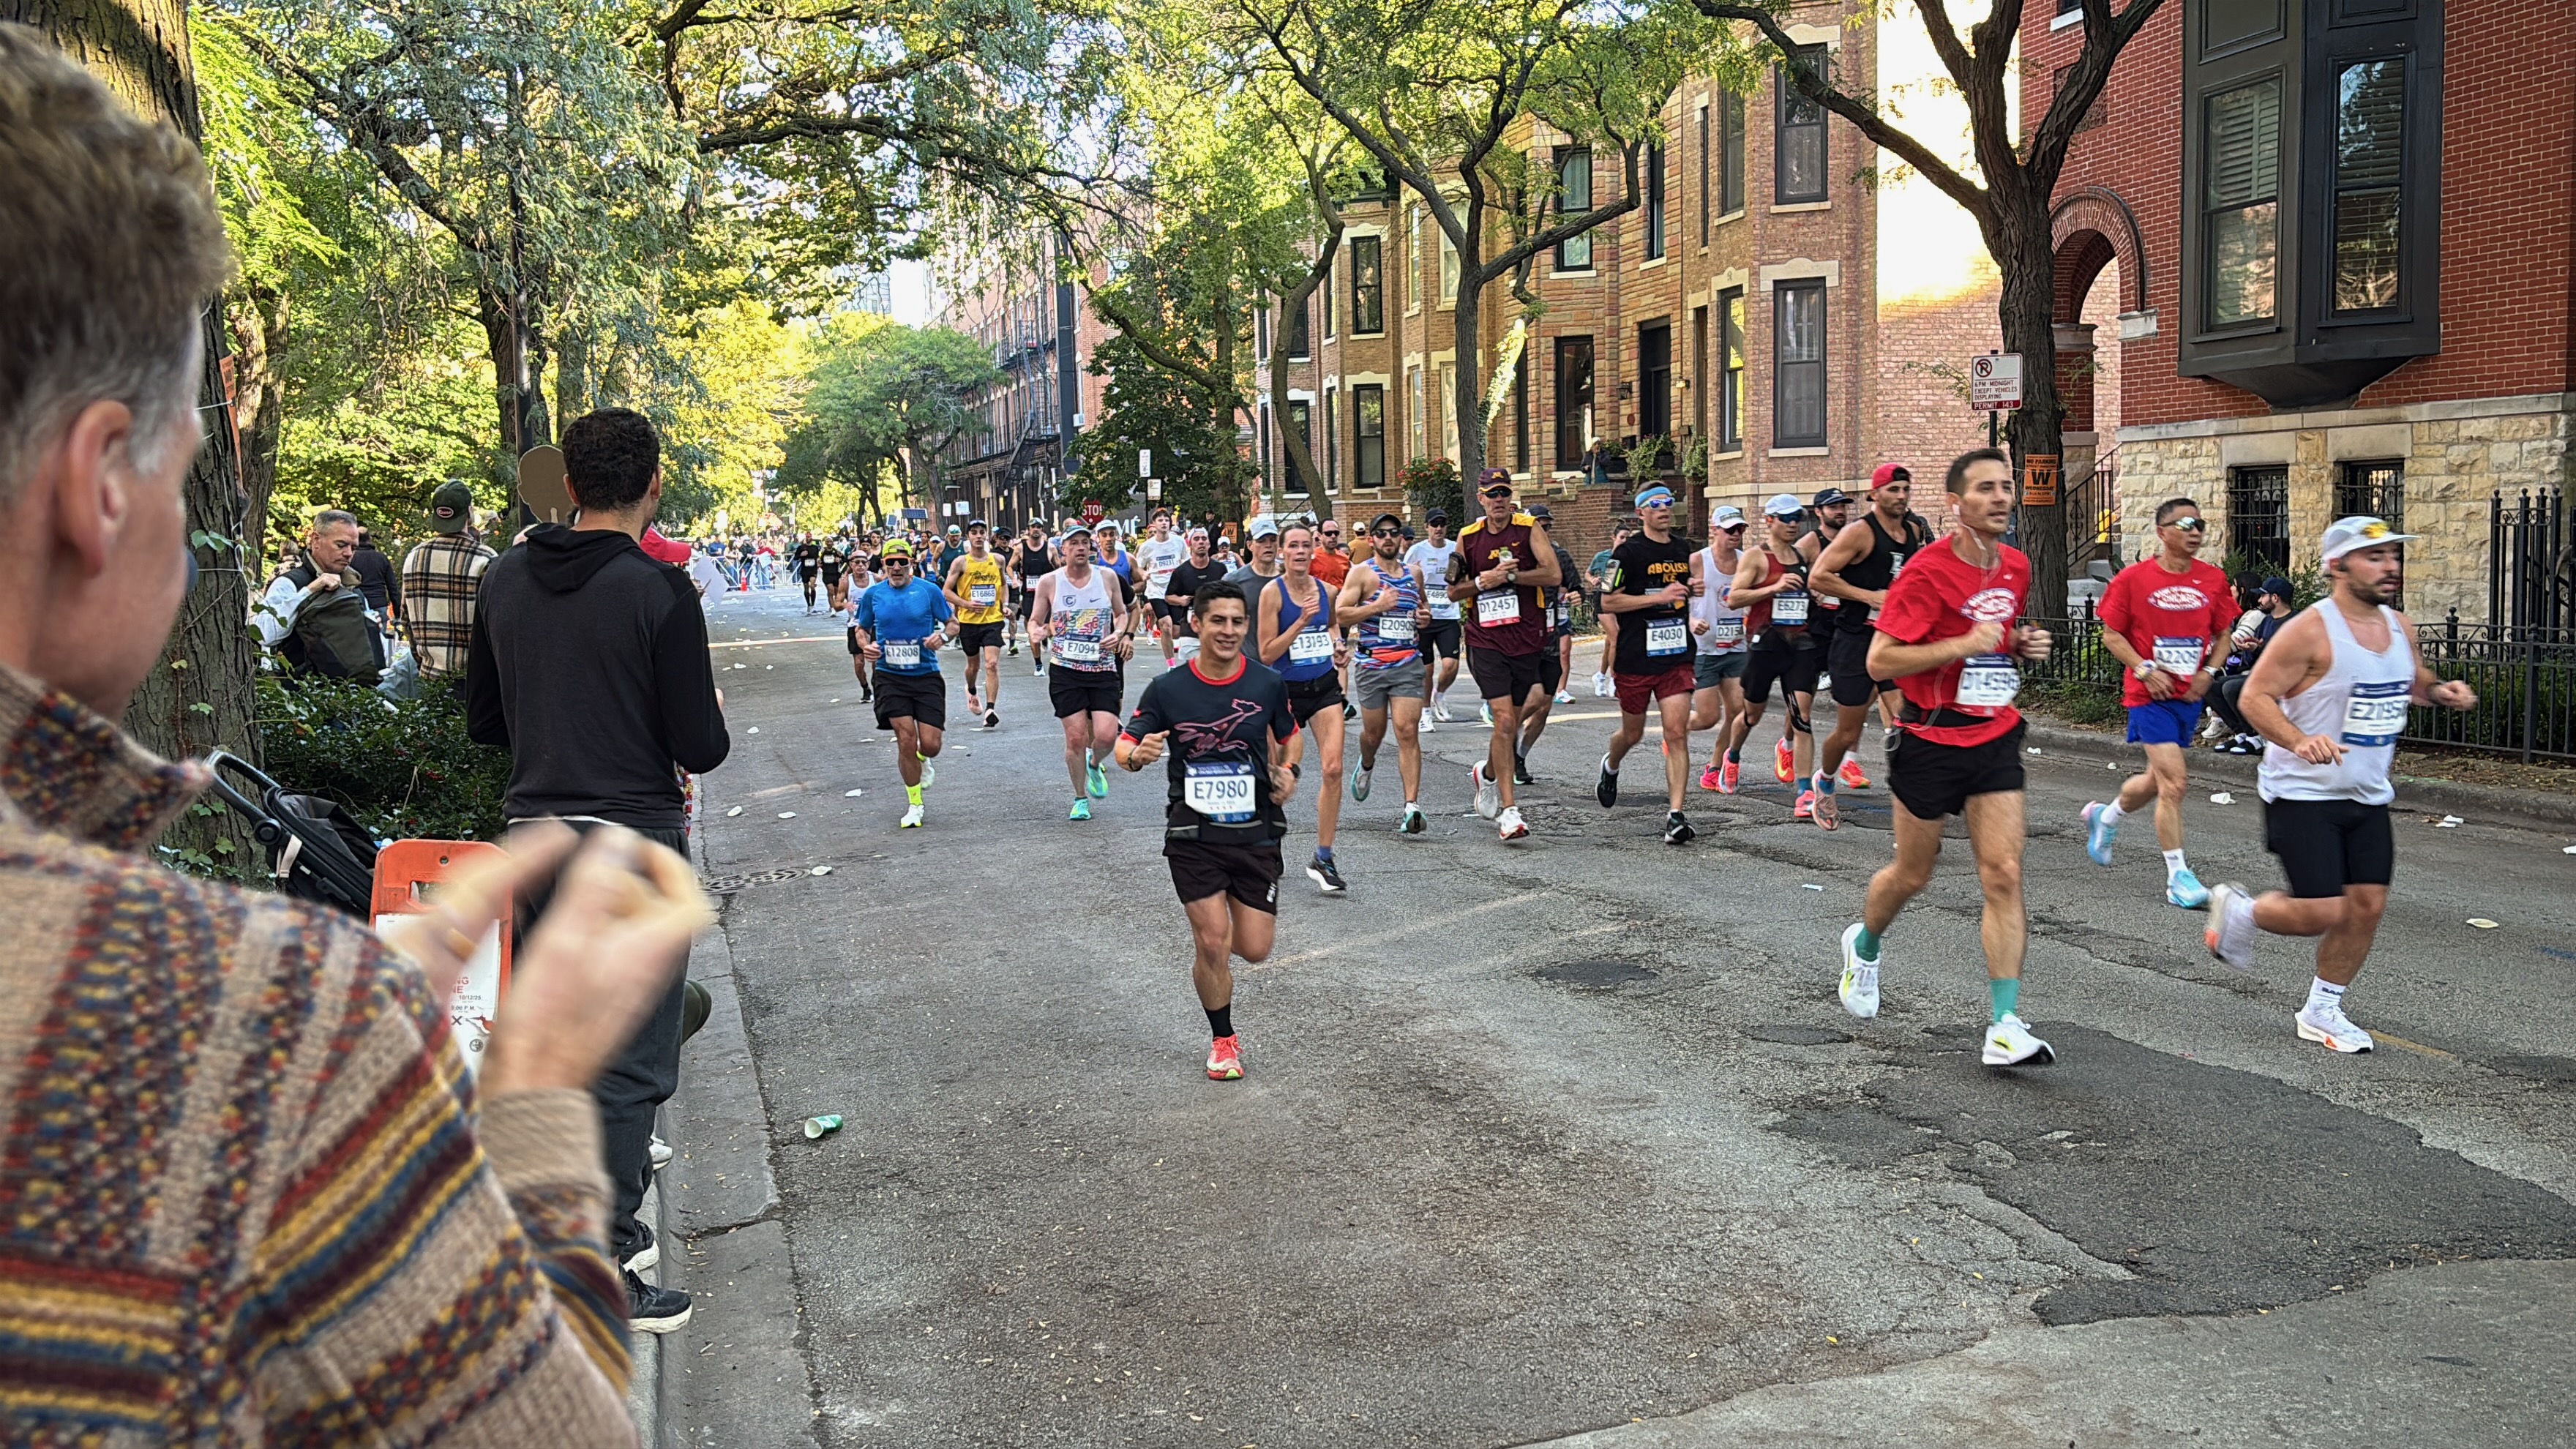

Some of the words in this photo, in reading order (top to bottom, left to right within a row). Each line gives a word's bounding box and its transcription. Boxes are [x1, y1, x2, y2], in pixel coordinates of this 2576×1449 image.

[1974, 402, 1998, 410] PERMIT
[2031, 469, 2051, 485] W
[1647, 563, 1688, 574] ABOLISH
[1662, 573, 1677, 583] ICE
[1066, 596, 1074, 605] C
[1479, 597, 1516, 613] D12457
[1651, 628, 1682, 642] E4030
[1068, 642, 1096, 654] E7094
[1292, 634, 1330, 650] E13193
[886, 647, 918, 657] E12808
[1194, 779, 1248, 800] E7980
